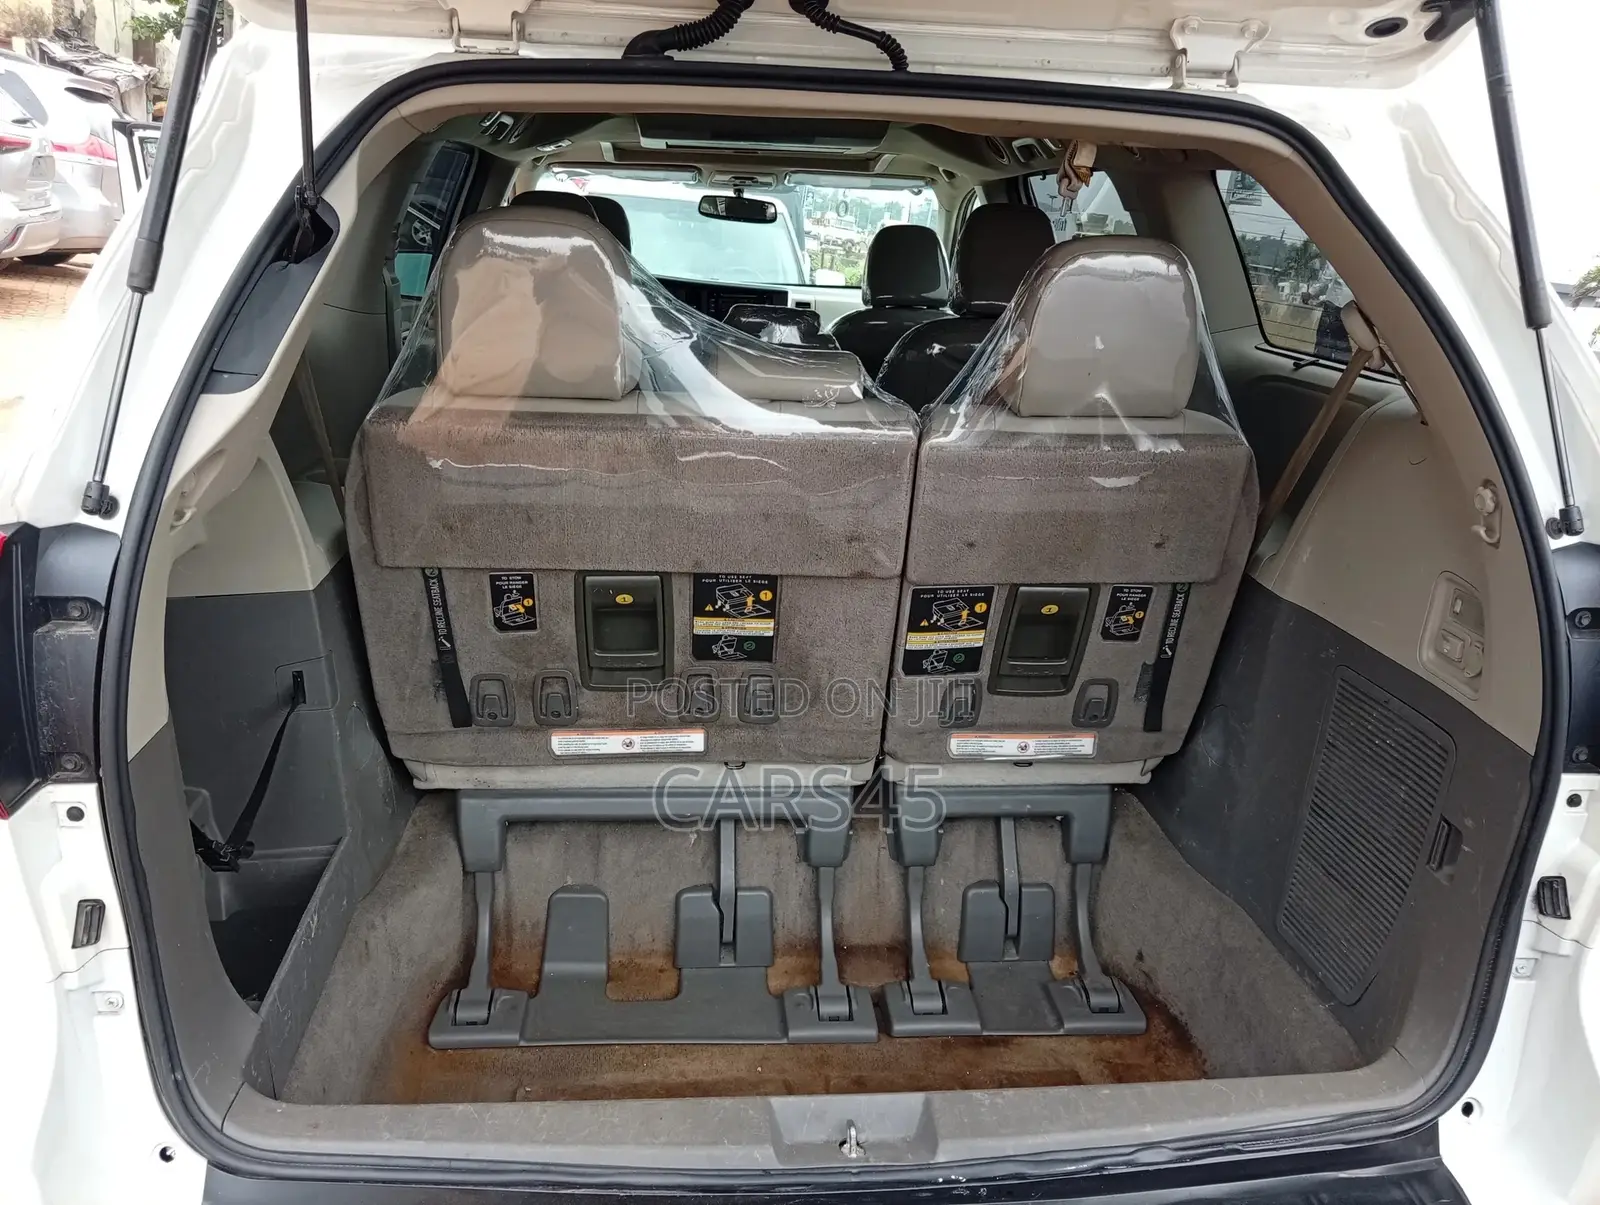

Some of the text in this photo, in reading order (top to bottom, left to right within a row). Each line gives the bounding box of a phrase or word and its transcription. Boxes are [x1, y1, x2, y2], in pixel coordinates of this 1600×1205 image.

[429, 578, 442, 606] SEATBACK
[433, 606, 446, 628] RECLINE
[1171, 593, 1185, 618] SEATBACK
[1166, 618, 1179, 638] RECLINE
